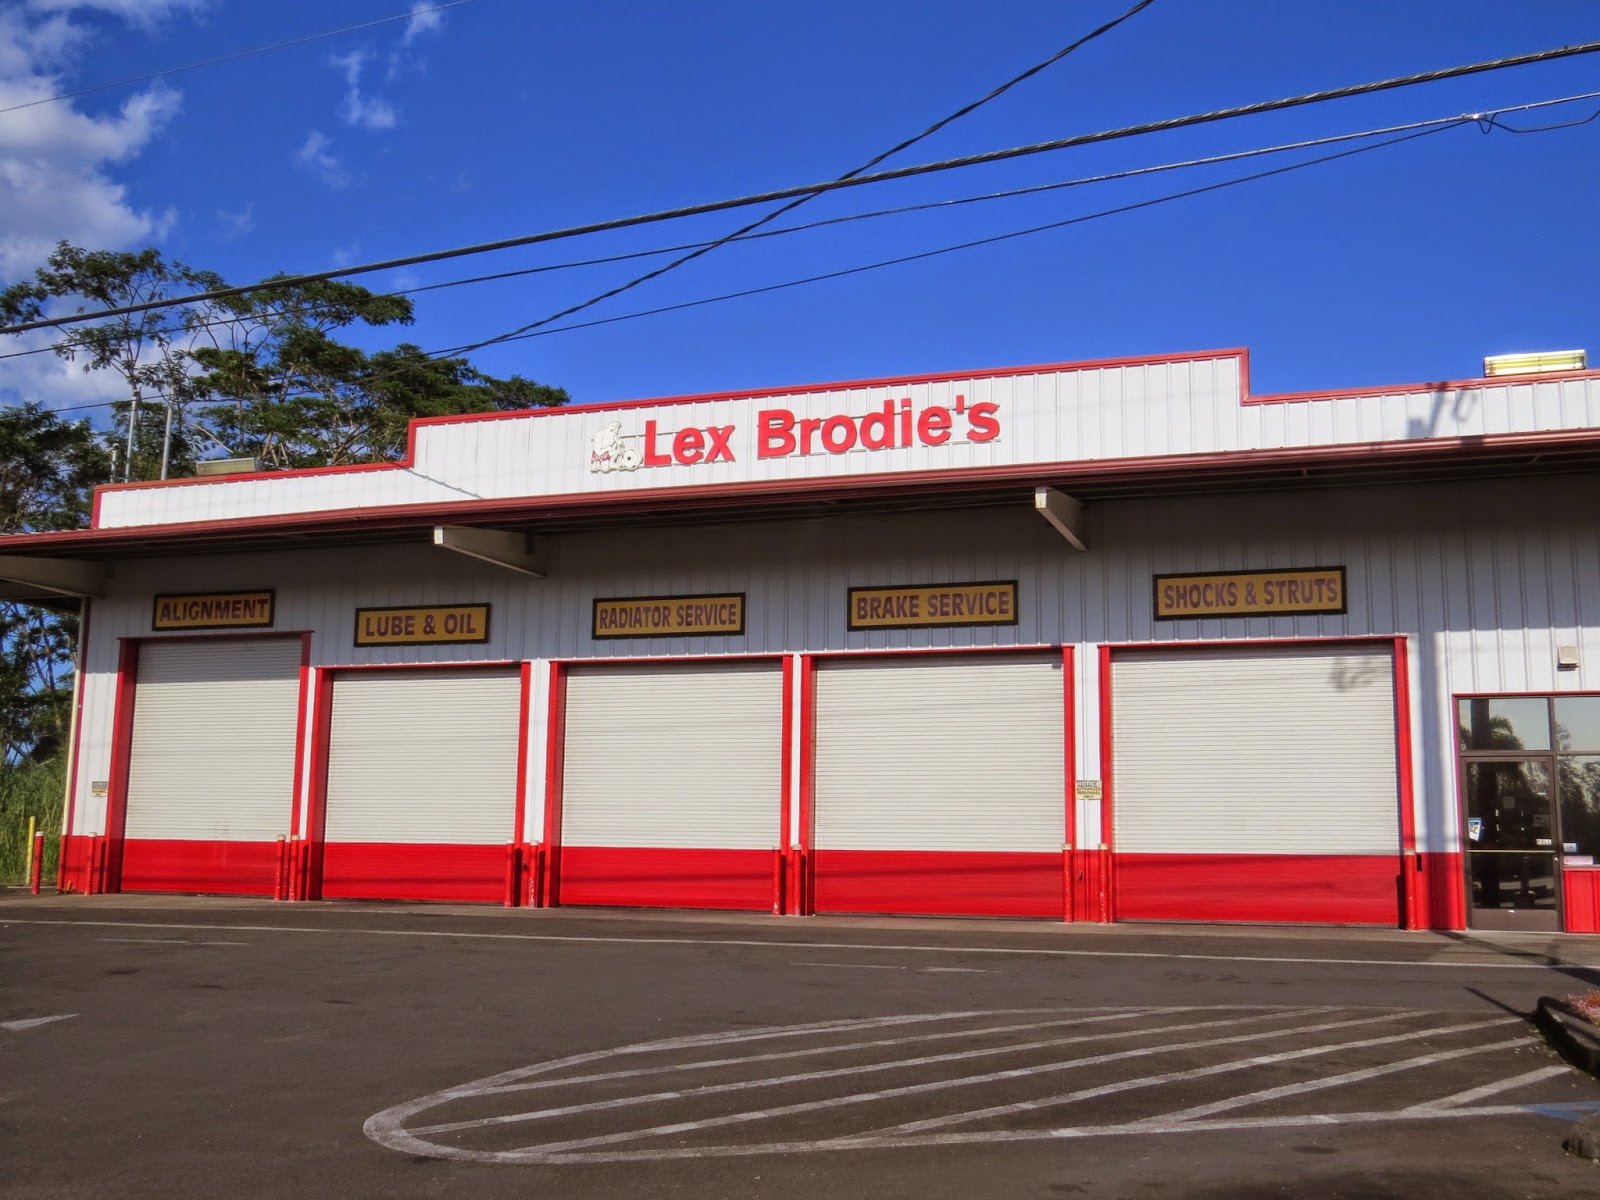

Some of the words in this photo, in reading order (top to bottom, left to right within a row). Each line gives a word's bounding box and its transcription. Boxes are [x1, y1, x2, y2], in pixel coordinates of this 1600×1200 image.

[643, 419, 736, 467] Lex
[757, 395, 1000, 459] Brodie's
[856, 594, 920, 620] BRAKE
[927, 591, 1010, 617] SERVICE
[1164, 582, 1238, 609] SHOCKS
[1245, 581, 1258, 606] &
[1263, 578, 1338, 605] STRUTS
[159, 598, 270, 622] ALIGNMENT
[599, 605, 670, 630] RADIATOR
[676, 602, 737, 628] SERVICE
[365, 614, 416, 637] LUBE
[422, 615, 437, 636] &
[444, 613, 477, 635] OIL
